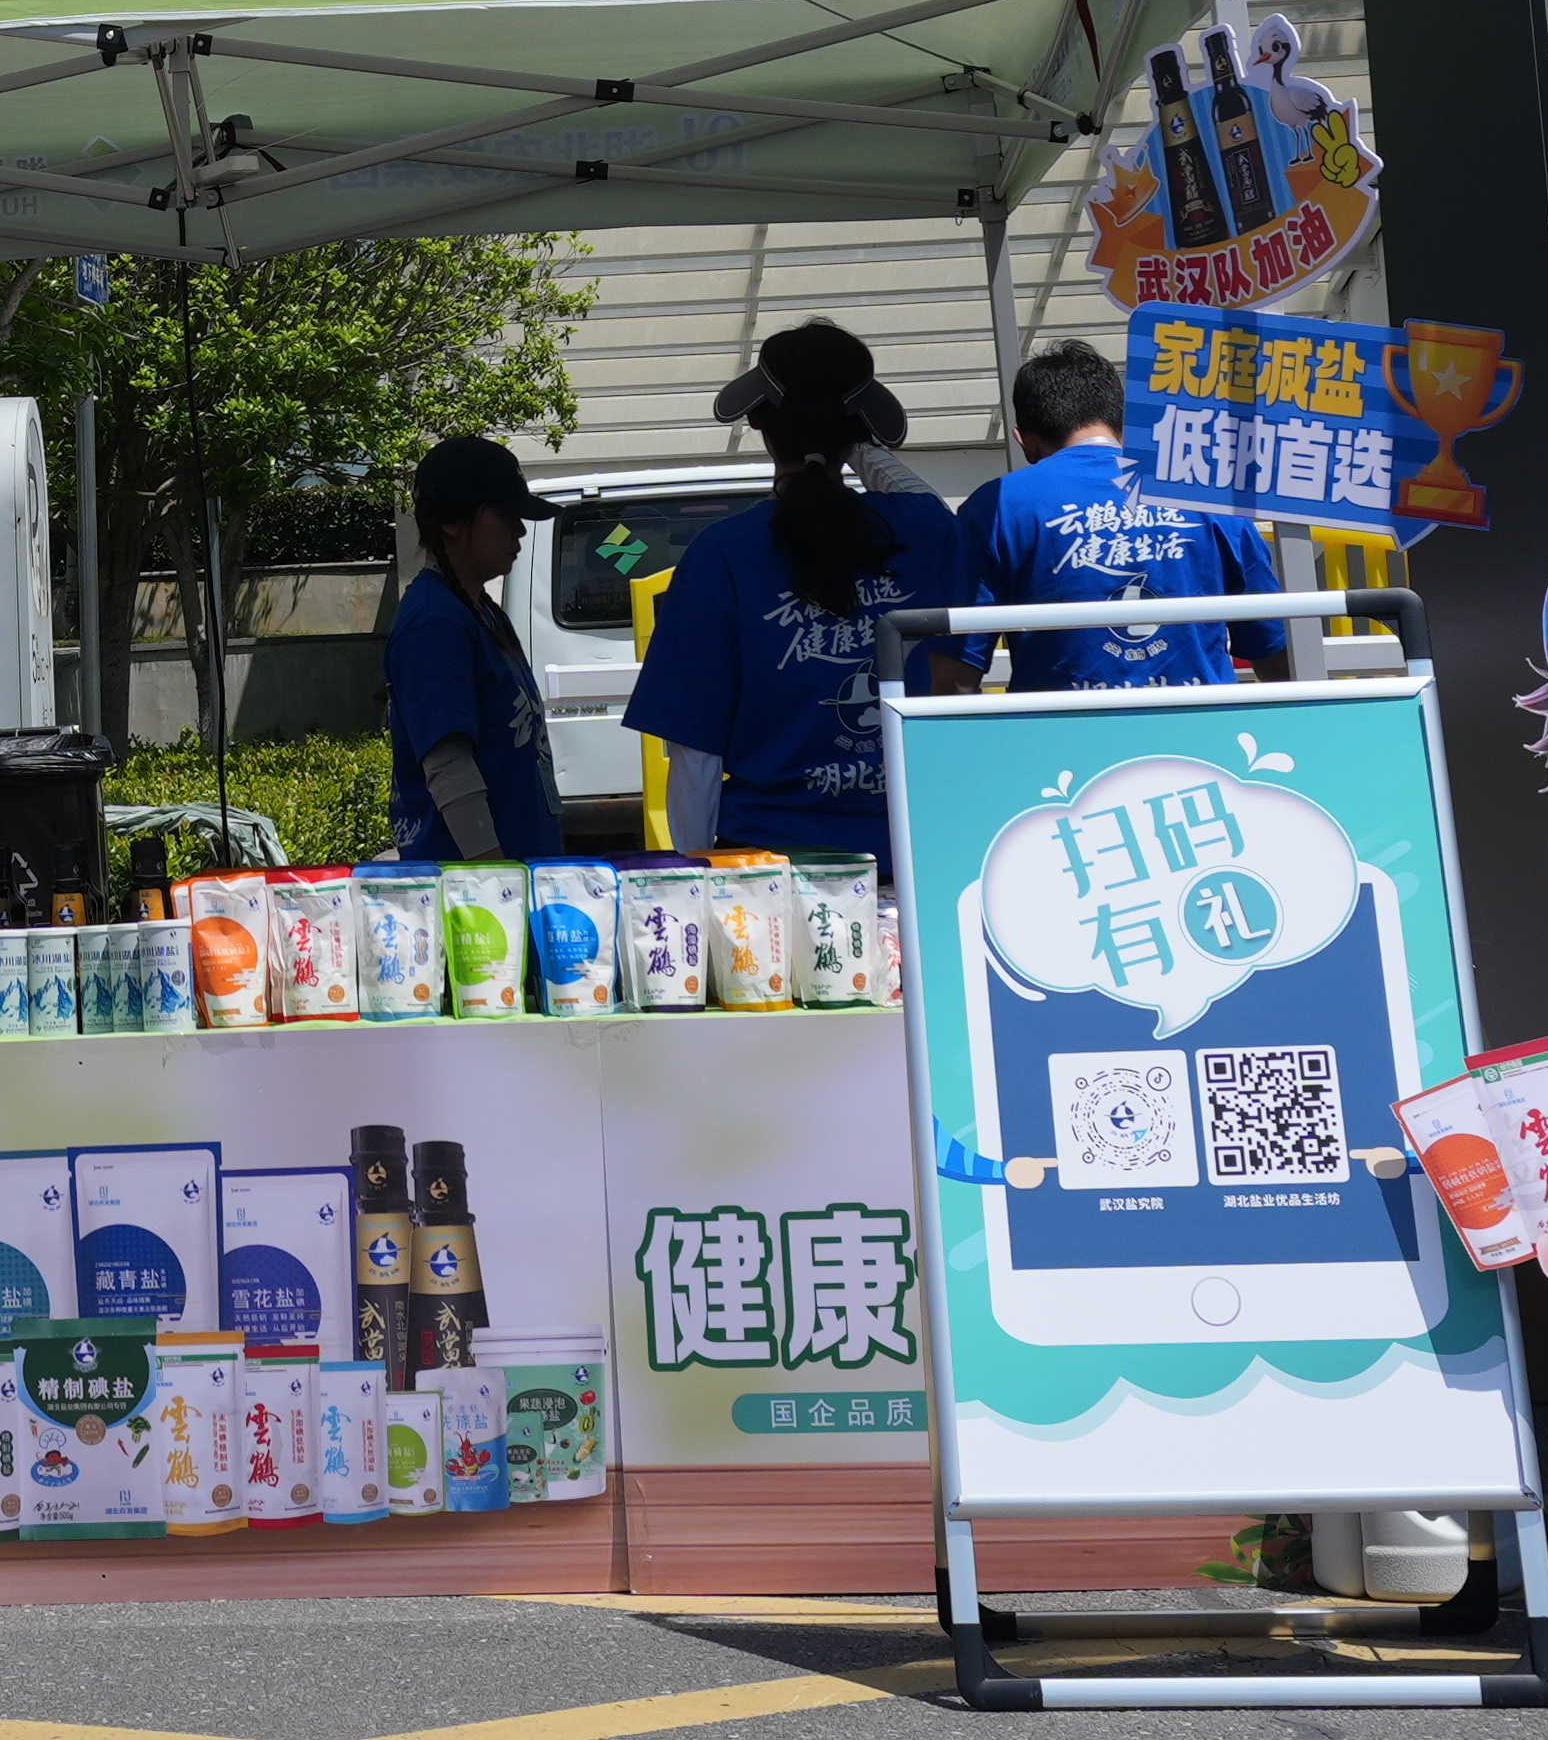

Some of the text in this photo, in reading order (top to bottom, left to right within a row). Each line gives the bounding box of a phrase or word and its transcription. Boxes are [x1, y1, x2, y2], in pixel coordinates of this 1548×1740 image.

[1135, 199, 1337, 307] 武汉队加油
[1148, 319, 1367, 419] 家庭减盐
[1150, 402, 1395, 511] 低钠首选
[1046, 499, 1206, 536] 云鹤甄选
[1052, 536, 1197, 576] 健康生活
[1051, 780, 1247, 900] 扫码
[1078, 884, 1273, 988] 有礼
[1098, 1195, 1166, 1213] 武汉盐究院
[1222, 1190, 1342, 1209] 湖北盐业优品生活坊
[95, 1268, 160, 1291] 藏青盐
[231, 1287, 294, 1310] 雪花盐
[635, 1202, 917, 1372] 健康
[38, 1376, 135, 1401] 精制碘盐
[770, 1397, 915, 1428] 国企品质
